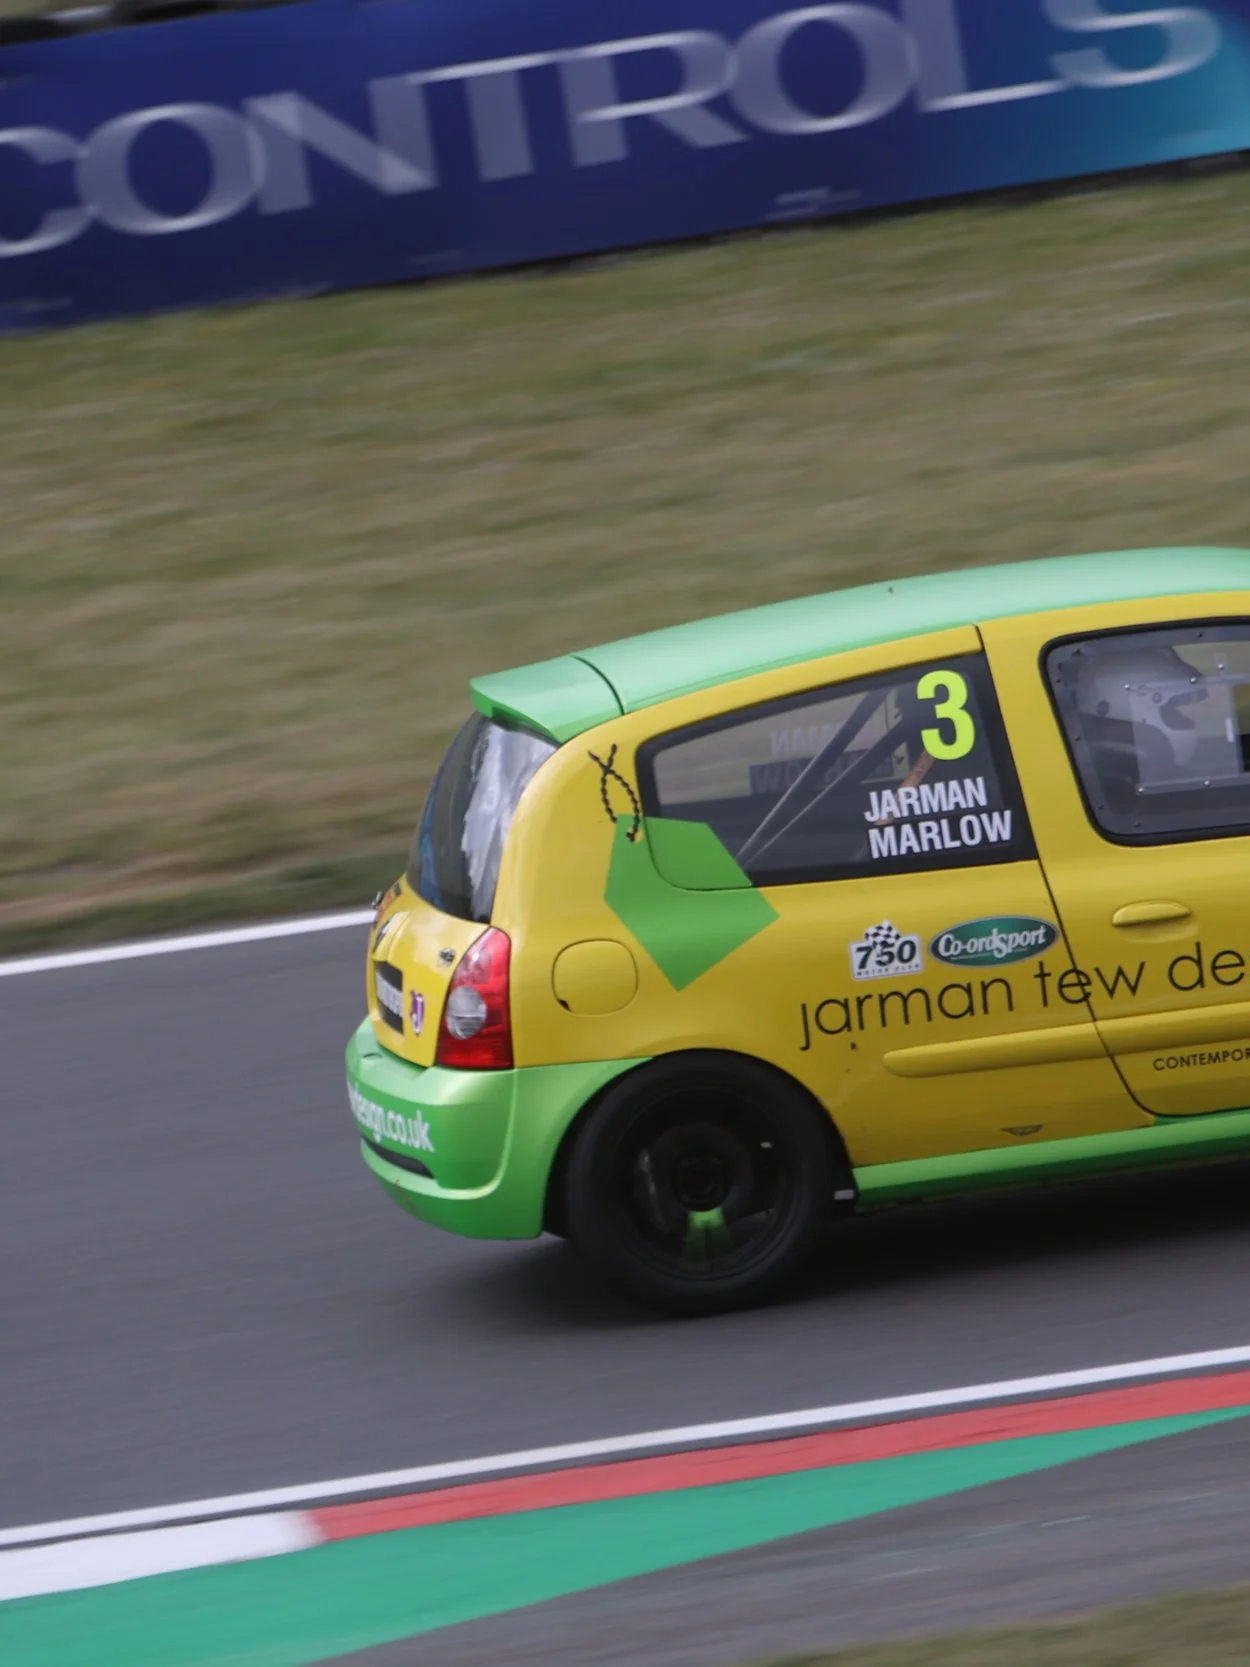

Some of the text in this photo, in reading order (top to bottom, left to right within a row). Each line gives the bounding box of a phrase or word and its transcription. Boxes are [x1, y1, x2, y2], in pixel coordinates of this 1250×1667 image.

[0, 0, 1224, 256] CONTROLS
[916, 669, 975, 760] 3
[863, 776, 987, 823] JARMAN
[868, 809, 1012, 859] MARLOW
[855, 939, 917, 970] 750
[799, 970, 1014, 1051] jarman
[1034, 961, 1146, 1005] tew
